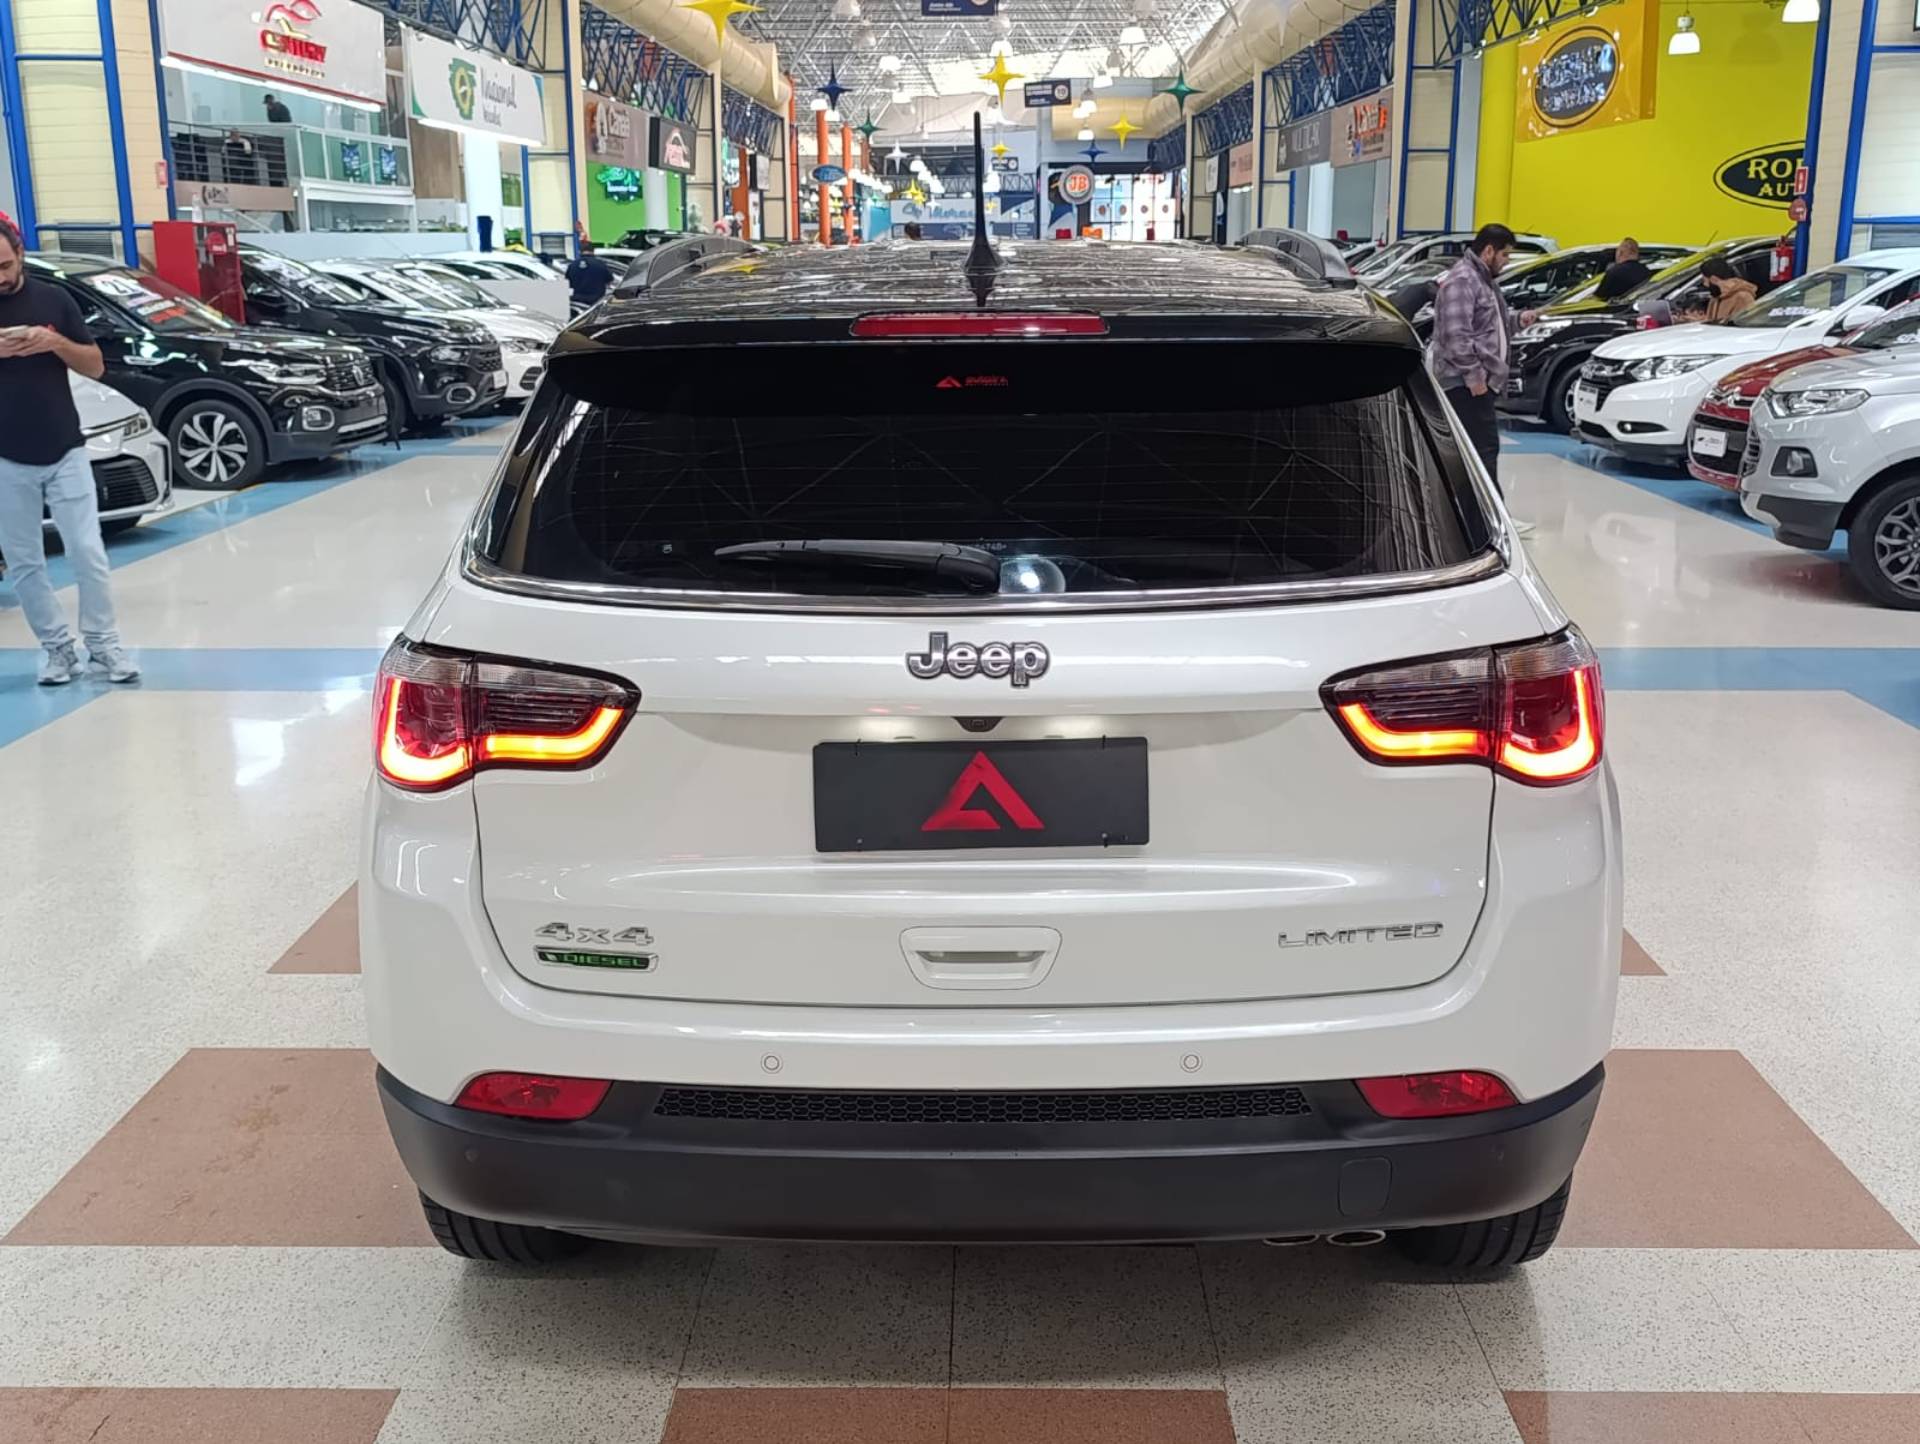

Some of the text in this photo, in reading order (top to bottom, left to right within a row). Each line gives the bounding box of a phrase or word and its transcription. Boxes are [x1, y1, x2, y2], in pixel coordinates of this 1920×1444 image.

[1069, 174, 1088, 192] JB
[906, 631, 1050, 688] Jeep
[534, 922, 655, 946] 4x4
[1278, 922, 1444, 948] LIMITED
[563, 953, 648, 968] DIESEL
